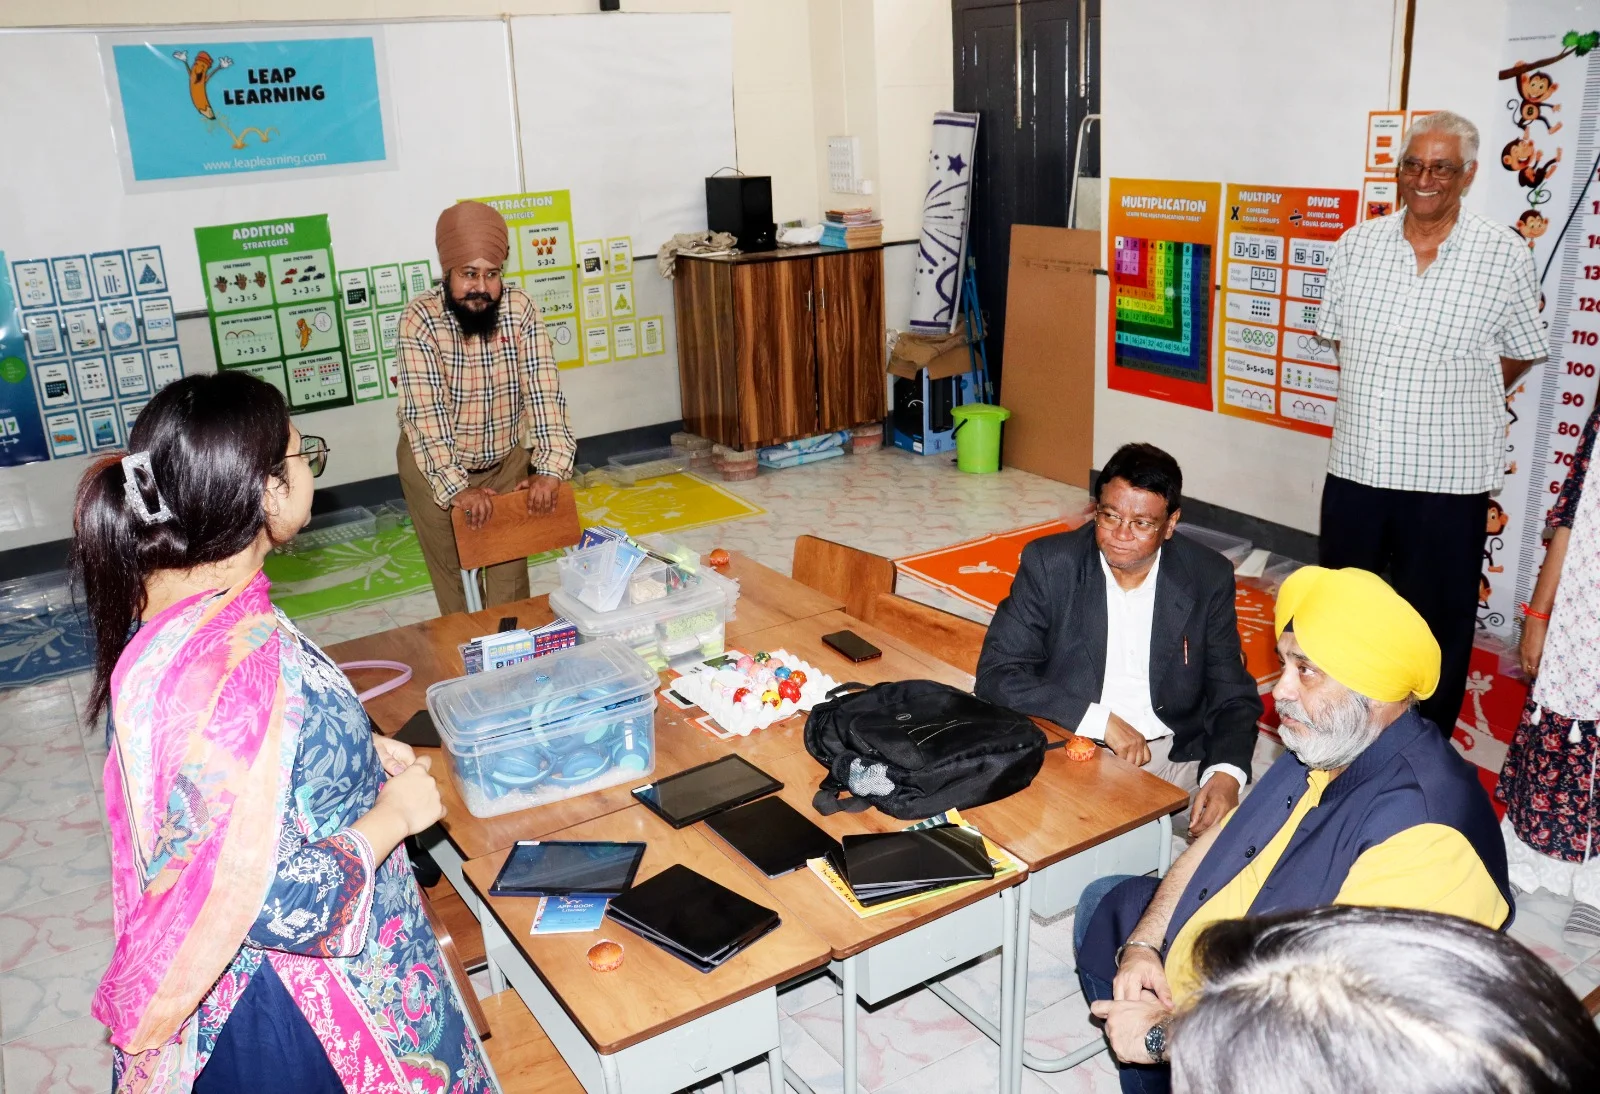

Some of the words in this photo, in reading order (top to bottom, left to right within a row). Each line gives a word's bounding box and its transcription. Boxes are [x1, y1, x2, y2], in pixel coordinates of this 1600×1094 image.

[248, 67, 296, 84] LEAP
[223, 84, 325, 105] LEARNING
[1527, 106, 1534, 116] 8
[203, 152, 327, 170] www.leaplearning.com
[1122, 196, 1207, 212] MULTIPLICATION
[1239, 191, 1282, 204] MULTIPLY
[1307, 196, 1340, 208] DIVIDE
[1260, 216, 1280, 224] GROUPS
[232, 222, 295, 240] ADDITION
[242, 238, 288, 250] STRATEGIES
[1238, 245, 1242, 253] 3
[1252, 246, 1256, 255] 5
[1268, 249, 1275, 257] 15
[1296, 252, 1304, 260] 15
[1316, 254, 1320, 262] 3
[1572, 330, 1598, 346] 110
[237, 348, 242, 356] 2
[1566, 361, 1595, 378] 100
[1562, 392, 1585, 407] 90
[8, 422, 16, 431] 7
[1558, 422, 1580, 437] 80
[1554, 451, 1574, 466] 70
